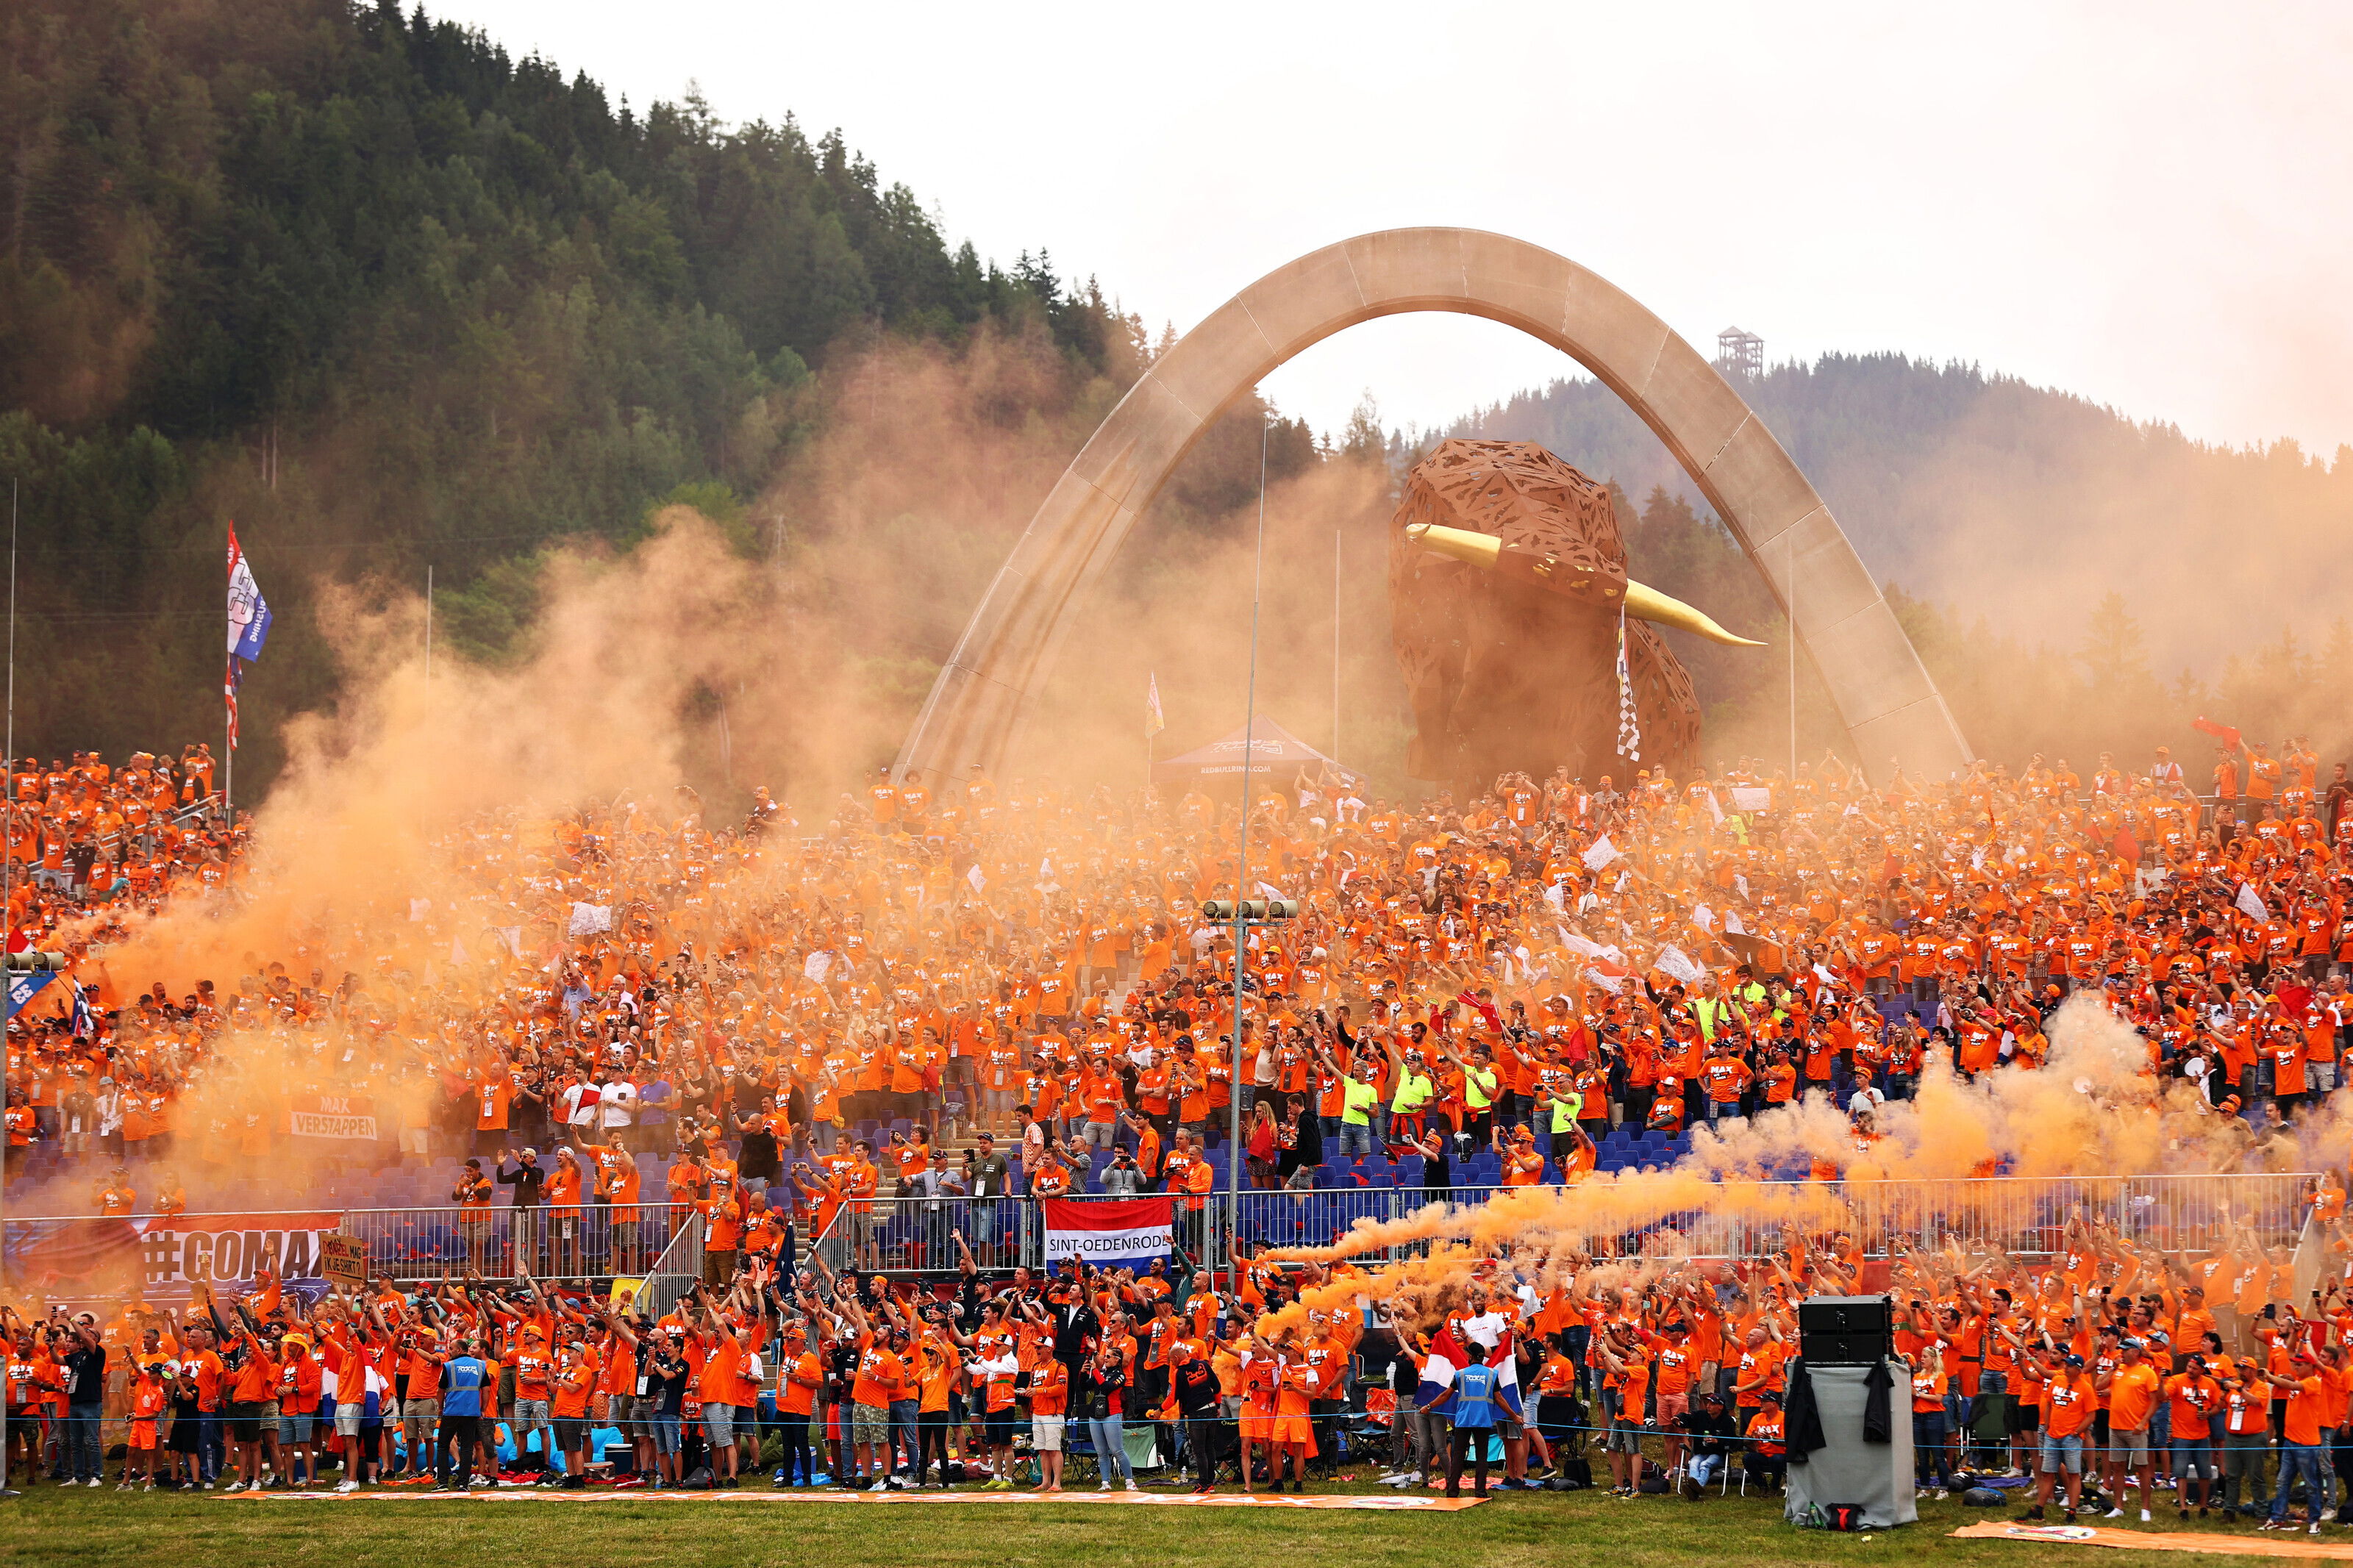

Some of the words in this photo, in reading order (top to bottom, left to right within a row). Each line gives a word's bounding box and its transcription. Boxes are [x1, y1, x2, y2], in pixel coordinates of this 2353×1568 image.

[1202, 765, 1271, 774] REDBULLRIN.COM
[1371, 821, 1389, 829] MAX
[1415, 847, 1435, 855] MAX
[1864, 941, 1882, 949] MAX
[1918, 943, 1936, 952] MAX
[2212, 951, 2232, 960] MAX
[1265, 973, 1283, 983] MAX
[1302, 970, 1320, 979] MAX
[1041, 980, 1060, 989] MAX
[1043, 1041, 1060, 1050] MAX
[1091, 1042, 1111, 1050] MAX
[2277, 1050, 2295, 1058] MAX
[826, 1059, 844, 1068] MAX
[1210, 1067, 1229, 1076] MAX
[1540, 1070, 1561, 1078] MAX
[1711, 1066, 1732, 1075] MAX
[320, 1096, 351, 1114] MAX
[1656, 1105, 1674, 1114] MAX
[296, 1114, 374, 1136] VERSTAPPEN
[1170, 1158, 1189, 1167] MAX
[1041, 1178, 1059, 1187] MAX
[349, 1245, 361, 1259] MAG
[1333, 1309, 1350, 1320] MAX
[1309, 1350, 1329, 1358] MAX
[1663, 1349, 1685, 1363] MAX
[519, 1356, 540, 1367] MAX
[685, 1401, 701, 1409] MAX
[1131, 1494, 1327, 1506] MAX
